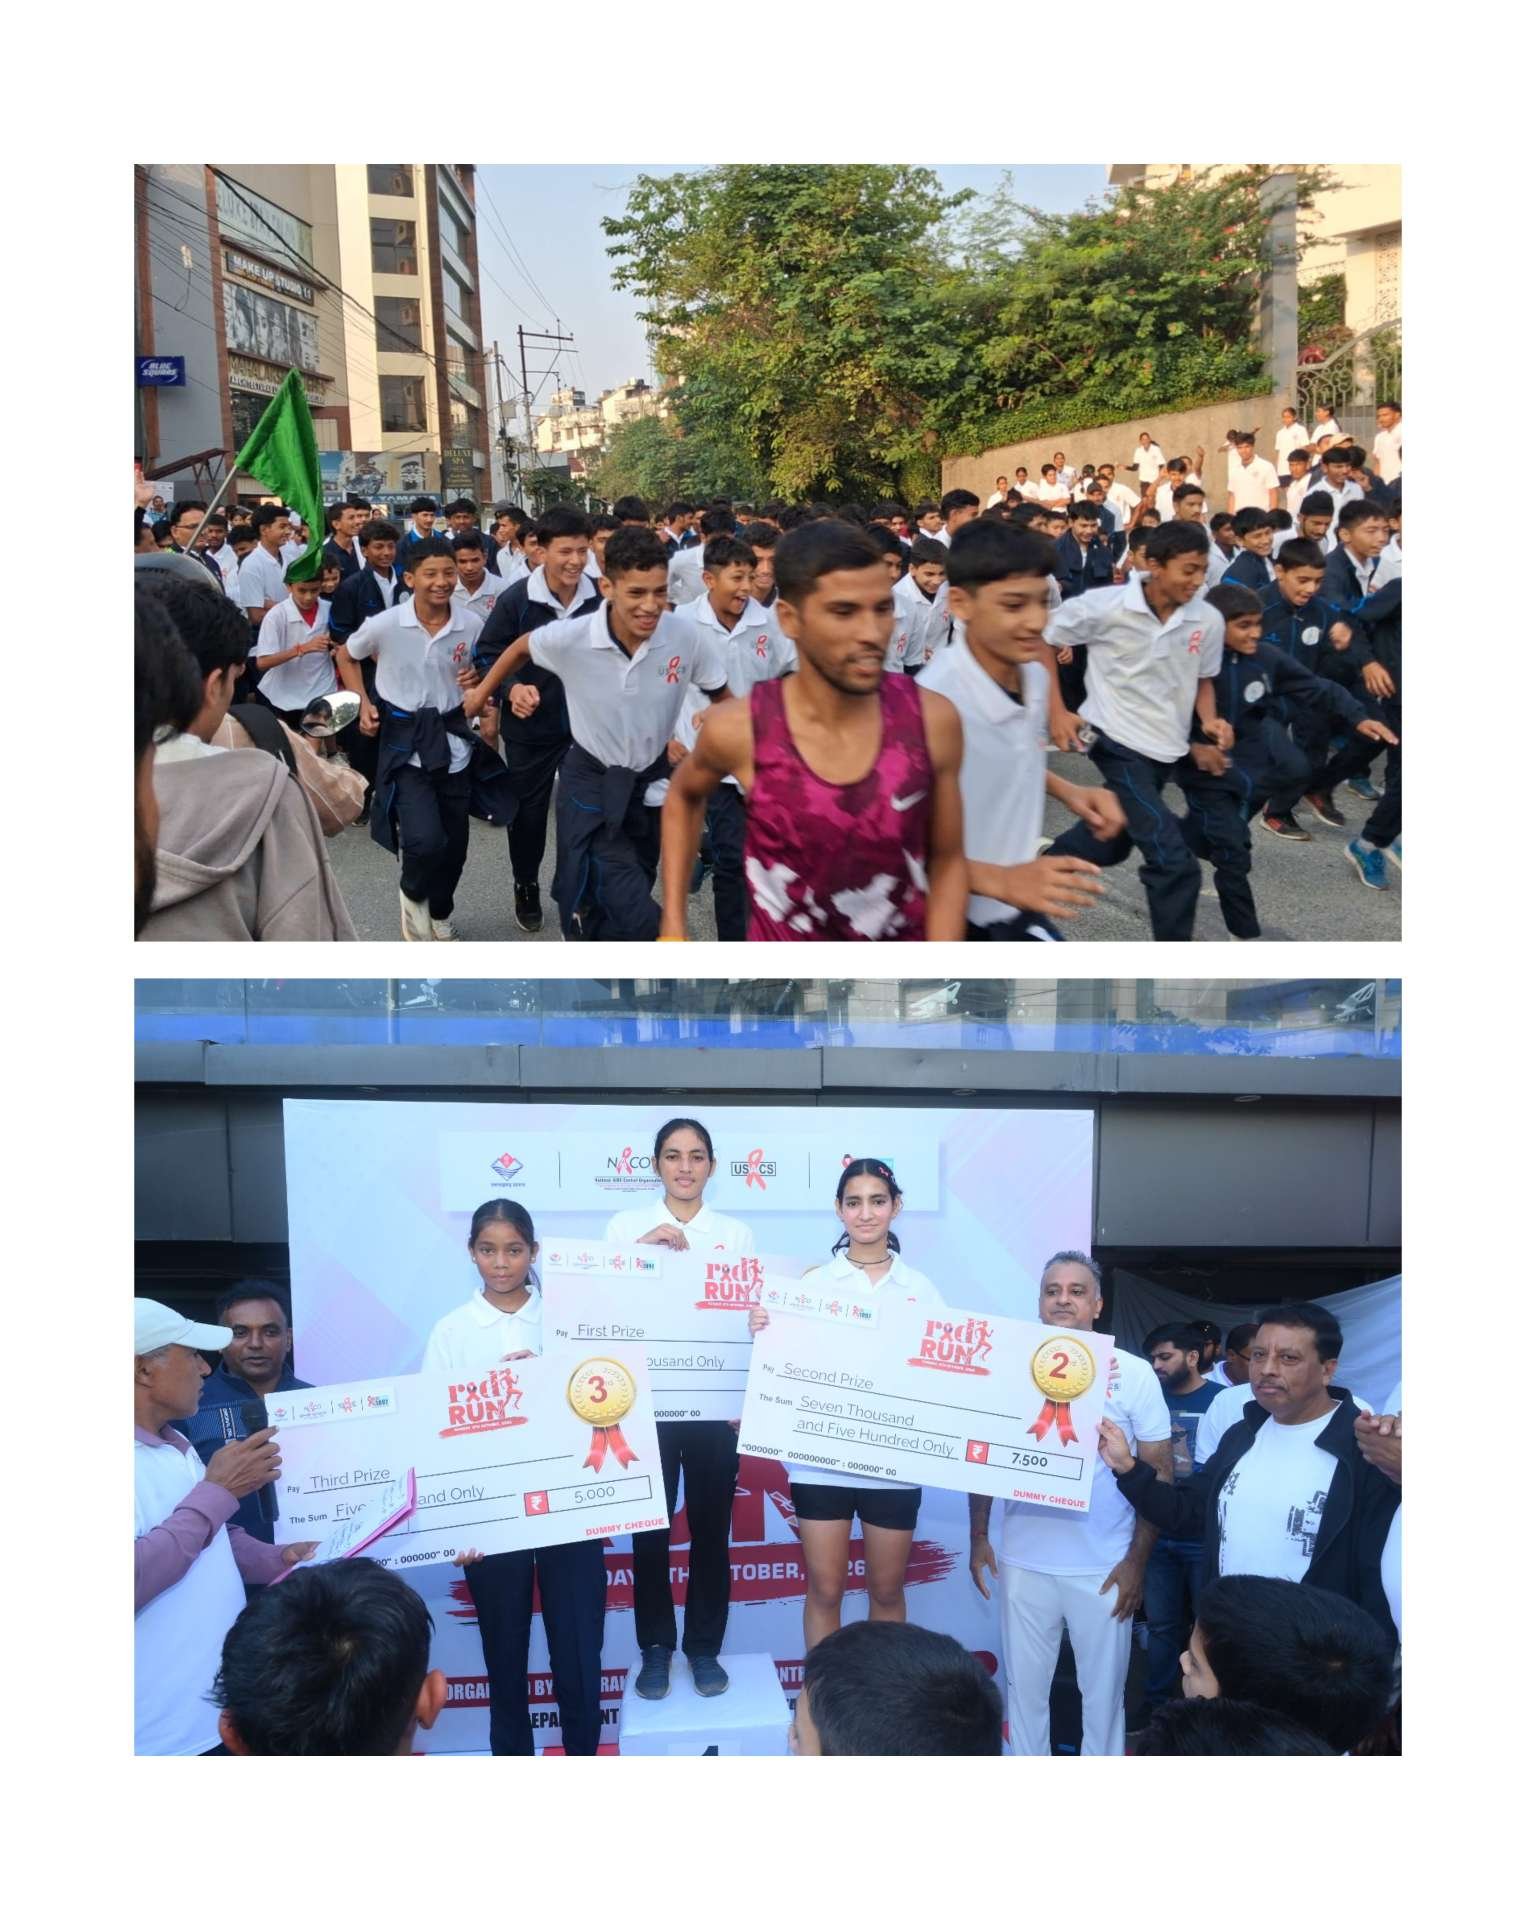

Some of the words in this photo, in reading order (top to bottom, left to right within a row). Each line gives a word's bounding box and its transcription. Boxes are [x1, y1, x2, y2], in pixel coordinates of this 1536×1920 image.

[704, 1281, 750, 1301] RUN
[556, 1328, 568, 1338] Pay
[577, 1323, 609, 1338] First
[611, 1324, 645, 1338] Prize
[695, 1355, 725, 1371] Only
[919, 1339, 974, 1365] RUN
[783, 1362, 838, 1383] Second
[840, 1372, 874, 1390] Prize
[447, 1399, 506, 1426] RUN
[759, 1393, 773, 1402] The
[775, 1396, 793, 1406] Sum
[800, 1394, 844, 1414] Seven
[847, 1403, 915, 1427] Thousand
[796, 1418, 824, 1433] and
[827, 1422, 856, 1439] Five
[859, 1427, 920, 1450] Hundred
[922, 1439, 955, 1458] Only
[287, 1485, 300, 1494] Pay
[310, 1471, 349, 1489] Third
[353, 1467, 391, 1483] Prize
[289, 1516, 306, 1525] The
[307, 1513, 328, 1523] Sum
[450, 1485, 485, 1500] Only
[1013, 1489, 1048, 1502] DUMMY
[1048, 1495, 1089, 1509] CHEQUE
[585, 1523, 622, 1537] DUMMY
[624, 1518, 665, 1530] CHEQUE
[534, 1679, 553, 1697] BY
